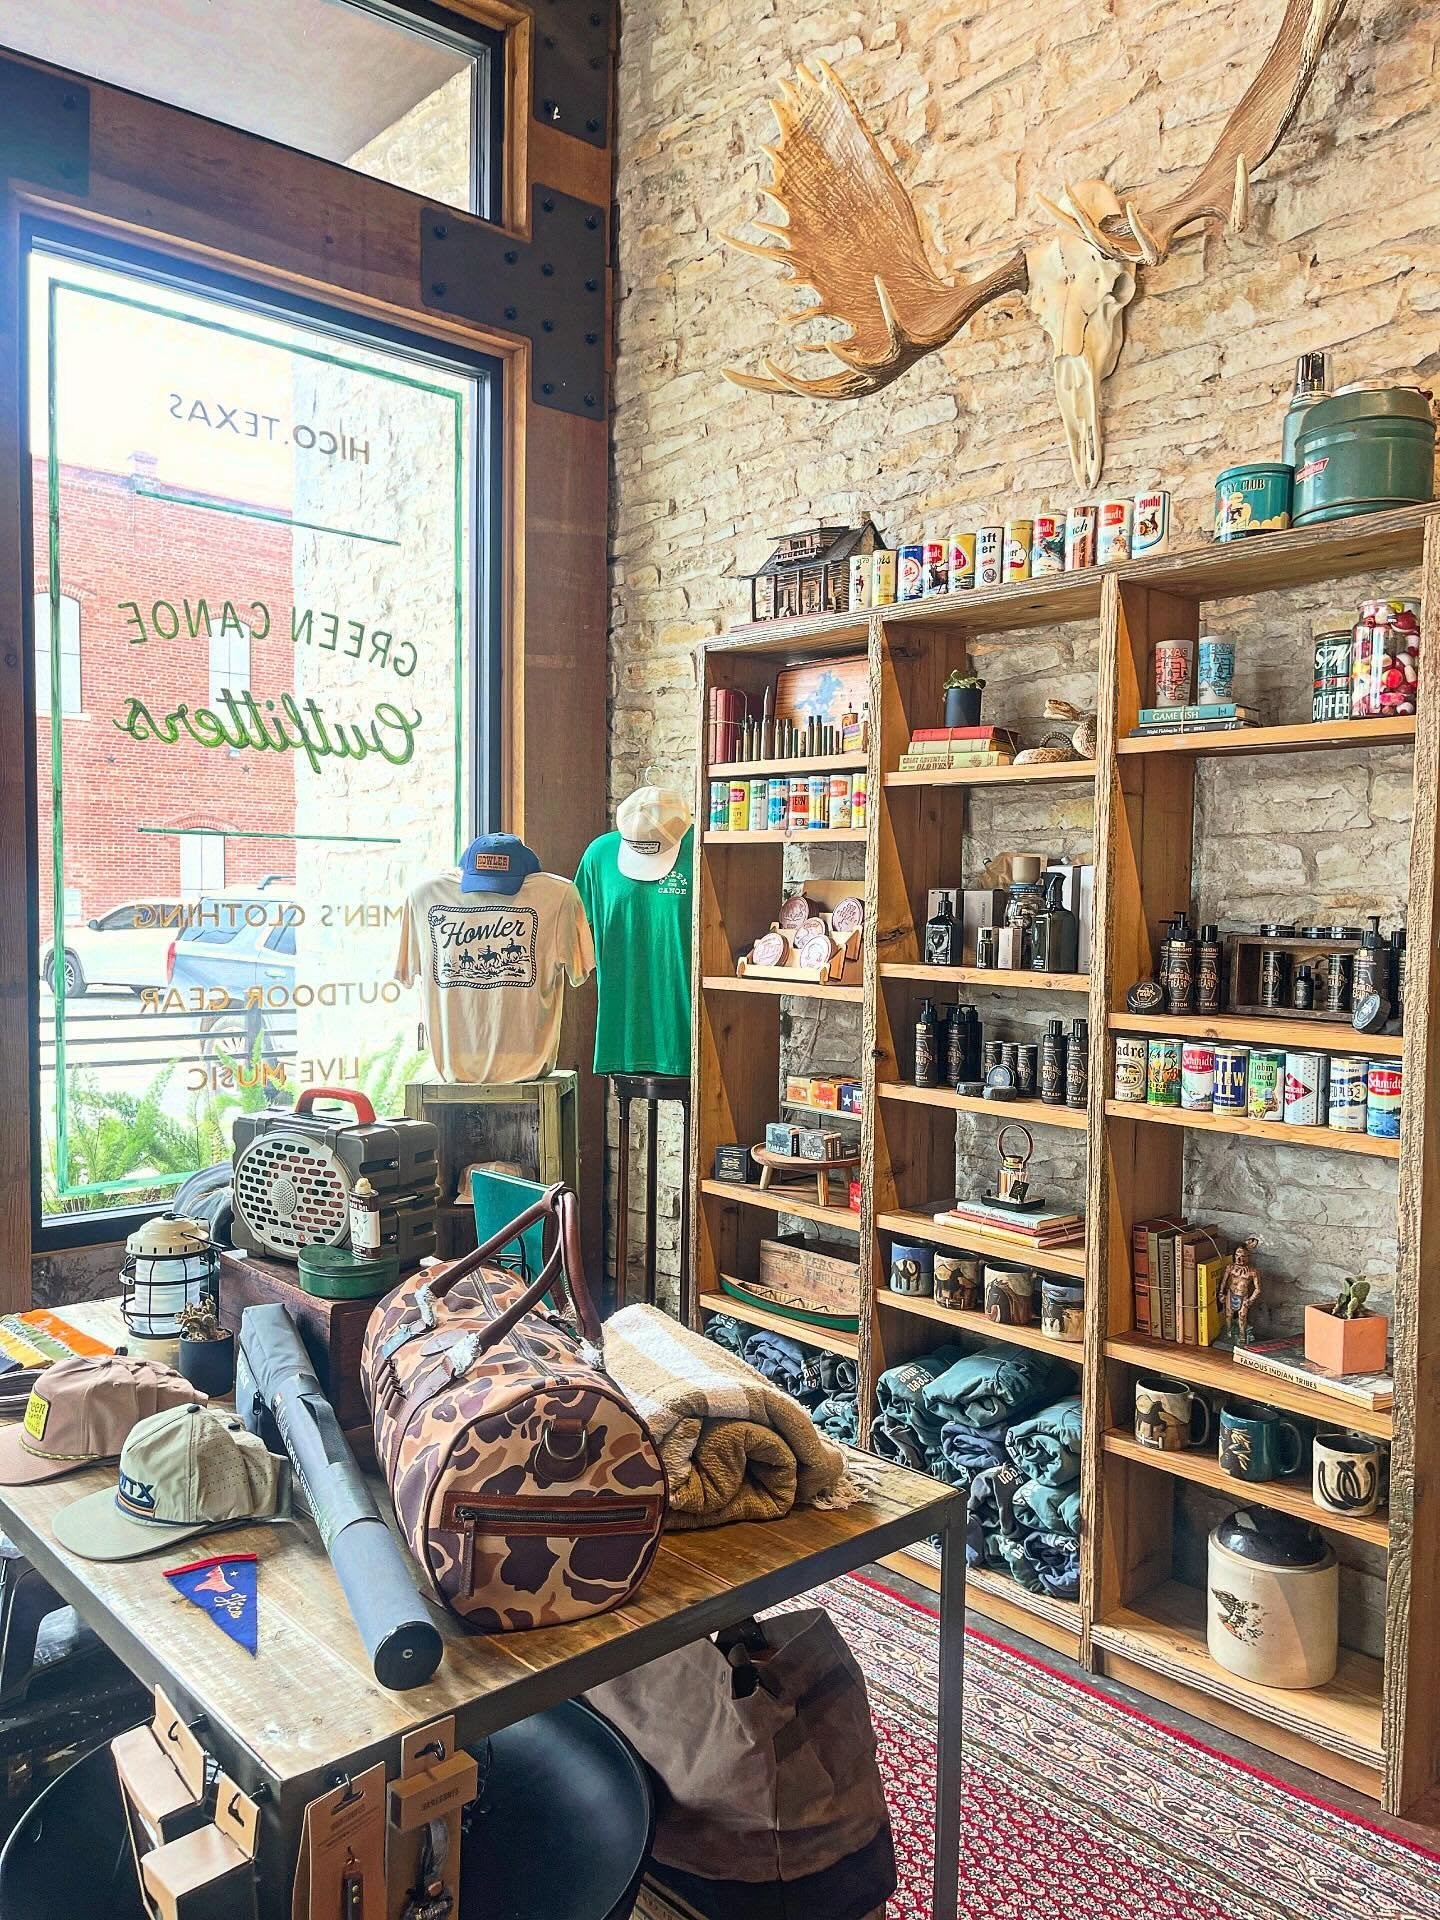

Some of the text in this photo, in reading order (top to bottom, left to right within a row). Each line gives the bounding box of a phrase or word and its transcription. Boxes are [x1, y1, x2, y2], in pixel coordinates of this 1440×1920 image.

[1241, 479, 1265, 491] CLUB
[981, 532, 997, 543] aft
[981, 544, 996, 554] er
[1152, 712, 1178, 721] GAME
[657, 887, 687, 895] CANOE
[440, 915, 526, 949] Howler
[1117, 1042, 1145, 1059] adre
[1183, 1052, 1213, 1067] Schmidt
[1163, 1250, 1173, 1329] LONGHORN EMPIRE
[1240, 1357, 1318, 1390] FAMOUS INDIAN TRIBES
